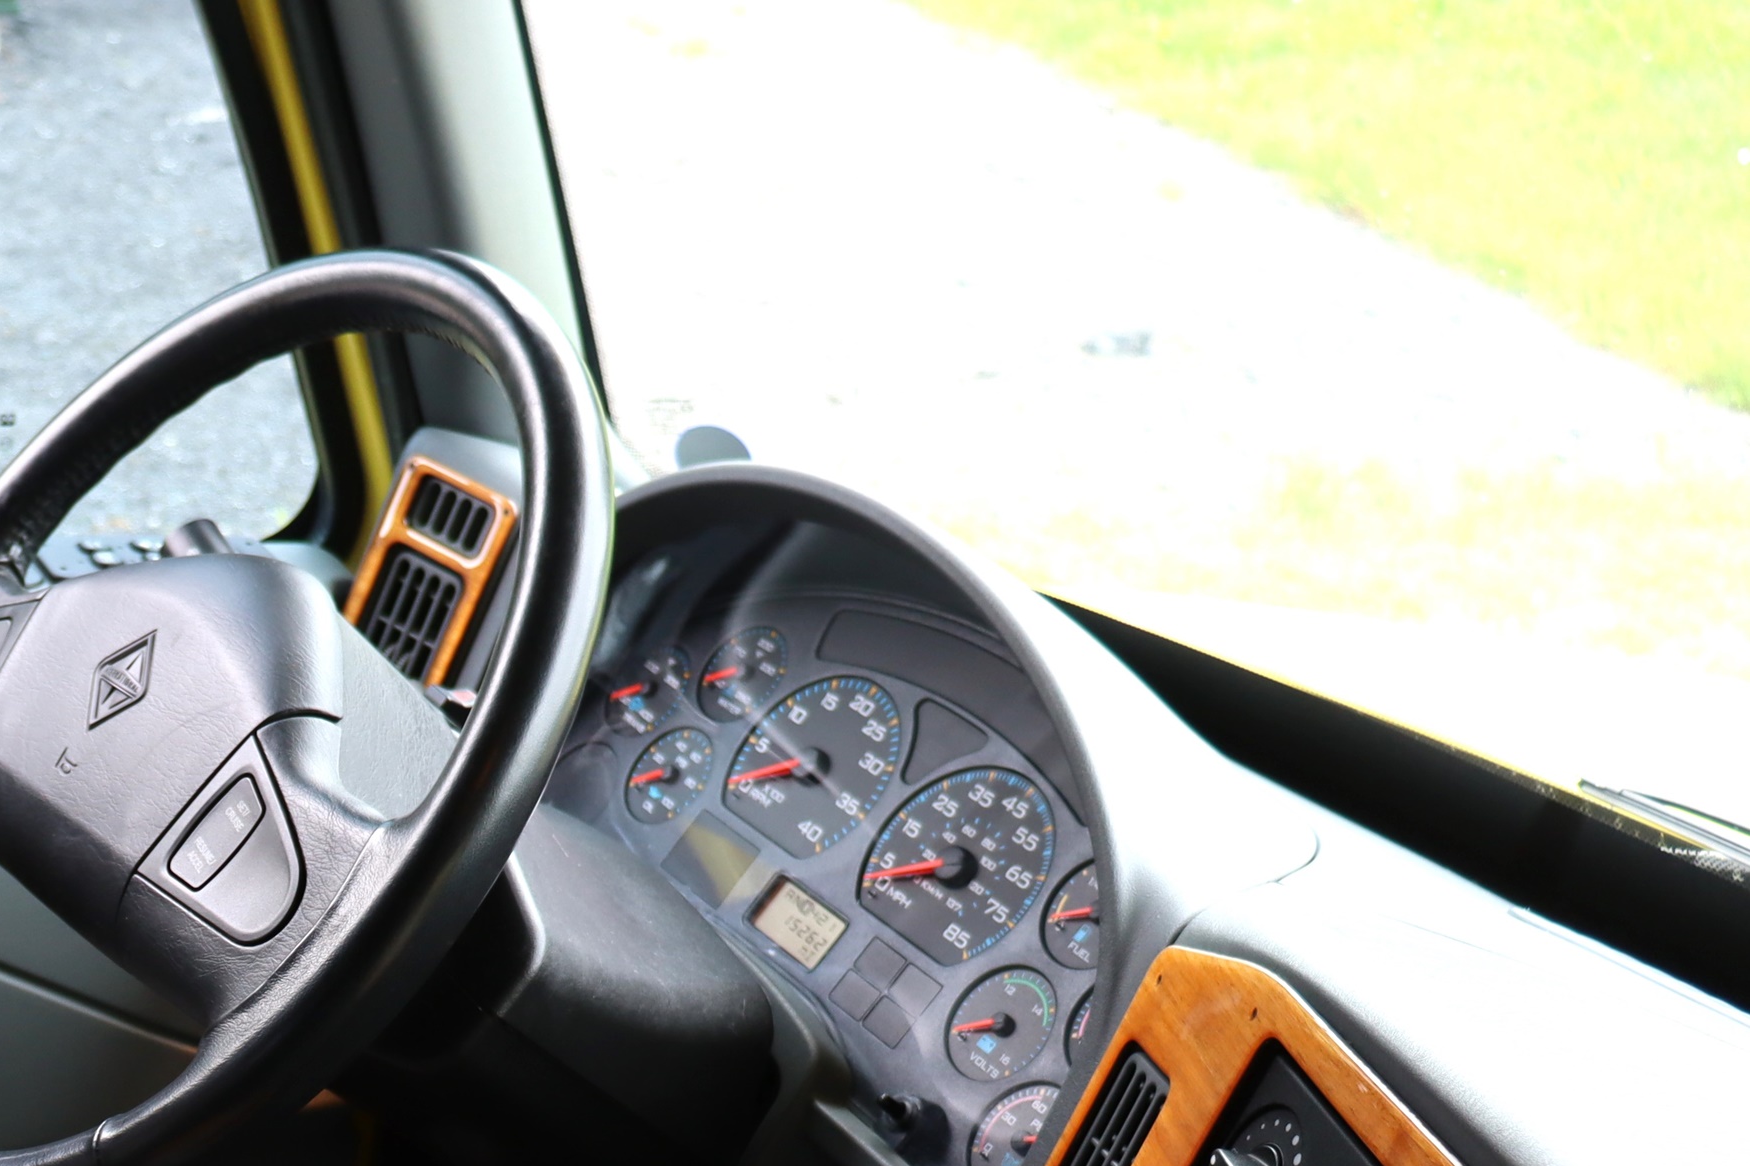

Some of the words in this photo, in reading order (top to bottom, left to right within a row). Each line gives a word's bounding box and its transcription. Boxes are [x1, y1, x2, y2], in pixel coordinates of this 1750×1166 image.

[820, 692, 839, 711] 15
[848, 694, 875, 717] 20
[788, 705, 808, 725] 10
[861, 719, 887, 742] 25
[755, 737, 770, 753] 5
[858, 752, 884, 776] 30
[835, 792, 860, 816] 35
[931, 793, 959, 818] 25
[968, 783, 995, 808] 35
[1002, 796, 1029, 819] 45
[225, 806, 245, 833] CRUISE
[902, 817, 921, 839] 15
[798, 820, 823, 843] 40
[942, 830, 957, 844] 40
[961, 824, 977, 839] 60
[1012, 827, 1040, 852] 55
[981, 837, 996, 852] 80
[879, 852, 896, 869] 5
[980, 856, 997, 872] 100
[1005, 865, 1033, 889] 65
[886, 886, 912, 909] MPH
[984, 898, 1010, 924] 75
[943, 923, 971, 949] 85
[1067, 941, 1090, 963] FUEL
[1004, 984, 1016, 996] 12
[1032, 1004, 1043, 1016] 14
[970, 1051, 1000, 1079] VOLTS
[999, 1053, 1011, 1066] 16
[1031, 1100, 1047, 1114] 60
[1001, 1111, 1017, 1126] 30
